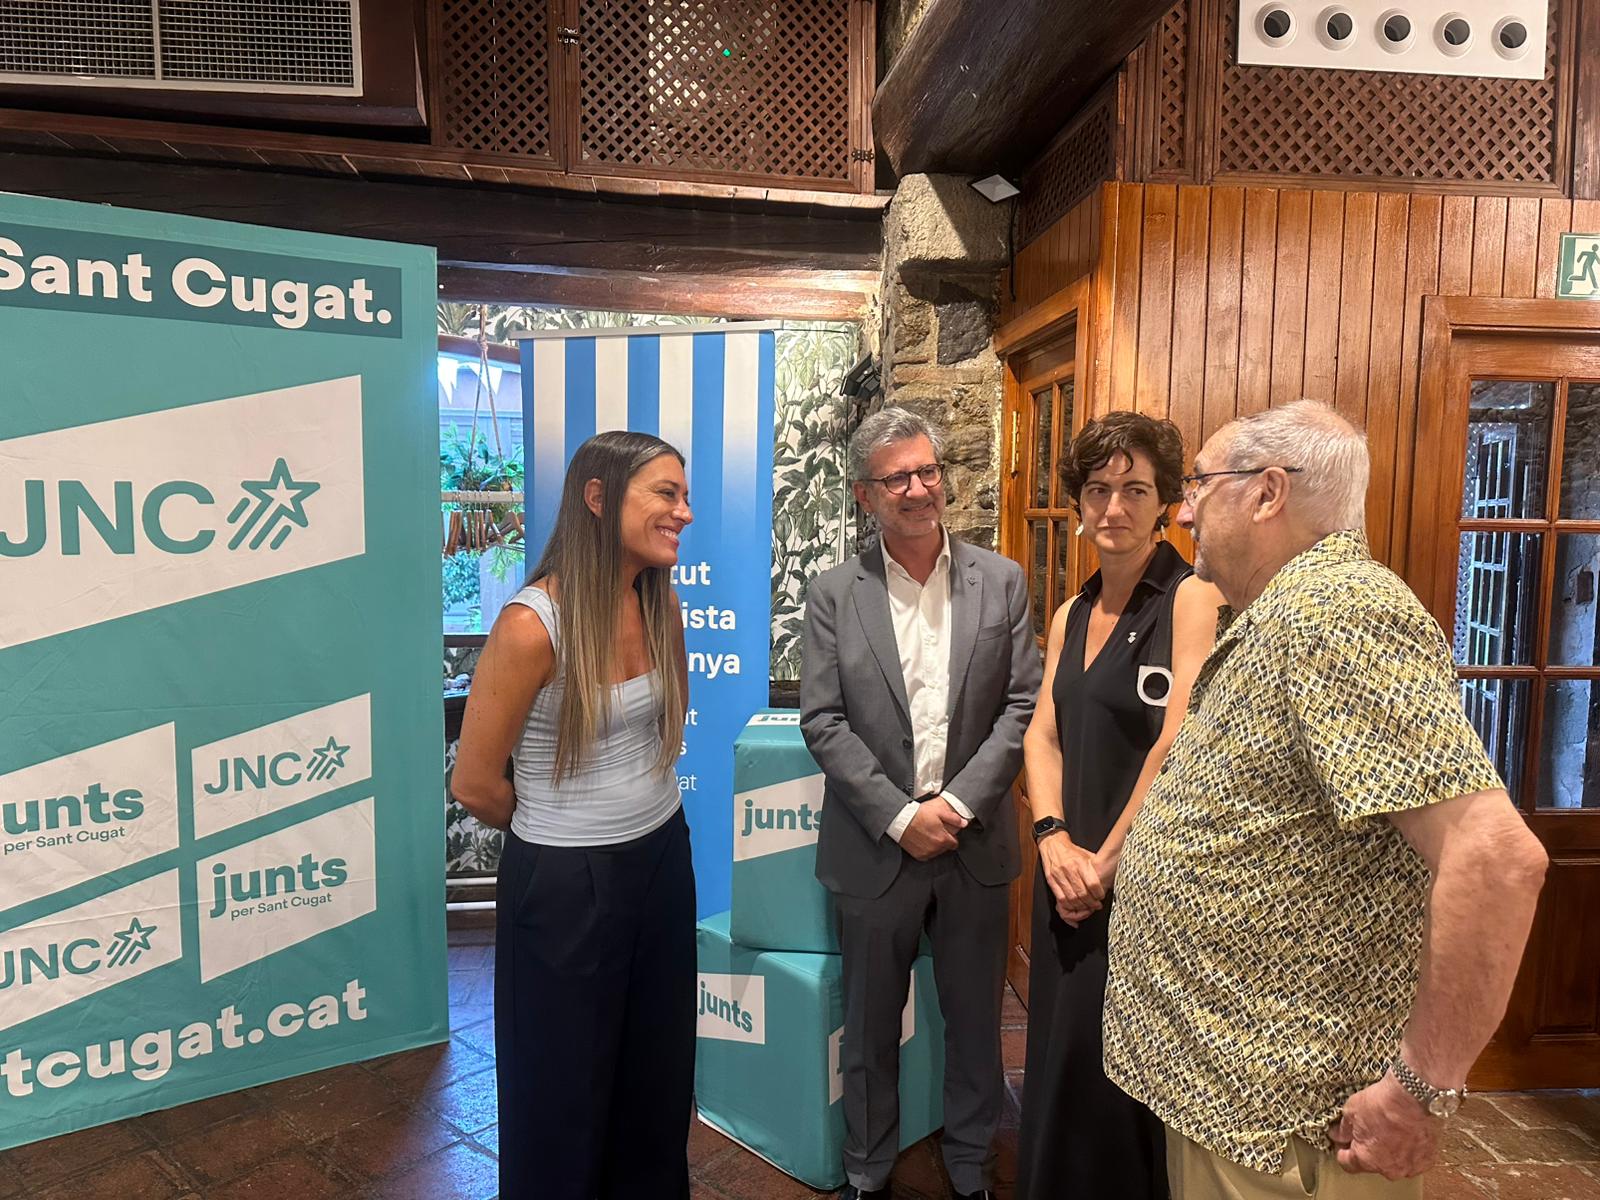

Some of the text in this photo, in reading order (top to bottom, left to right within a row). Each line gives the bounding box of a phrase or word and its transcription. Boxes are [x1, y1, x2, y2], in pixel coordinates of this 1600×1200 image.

[171, 257, 393, 329] Cugat.
[0, 479, 216, 557] JNC
[688, 652, 741, 680] nya
[203, 751, 302, 794] JNC
[2, 782, 144, 835] unts
[4, 826, 126, 855] per Sant Cugat
[209, 853, 348, 919] junts
[231, 892, 332, 921] per Sant Cugat
[698, 981, 753, 1033] junts
[0, 978, 368, 1097] tcugat.cat
